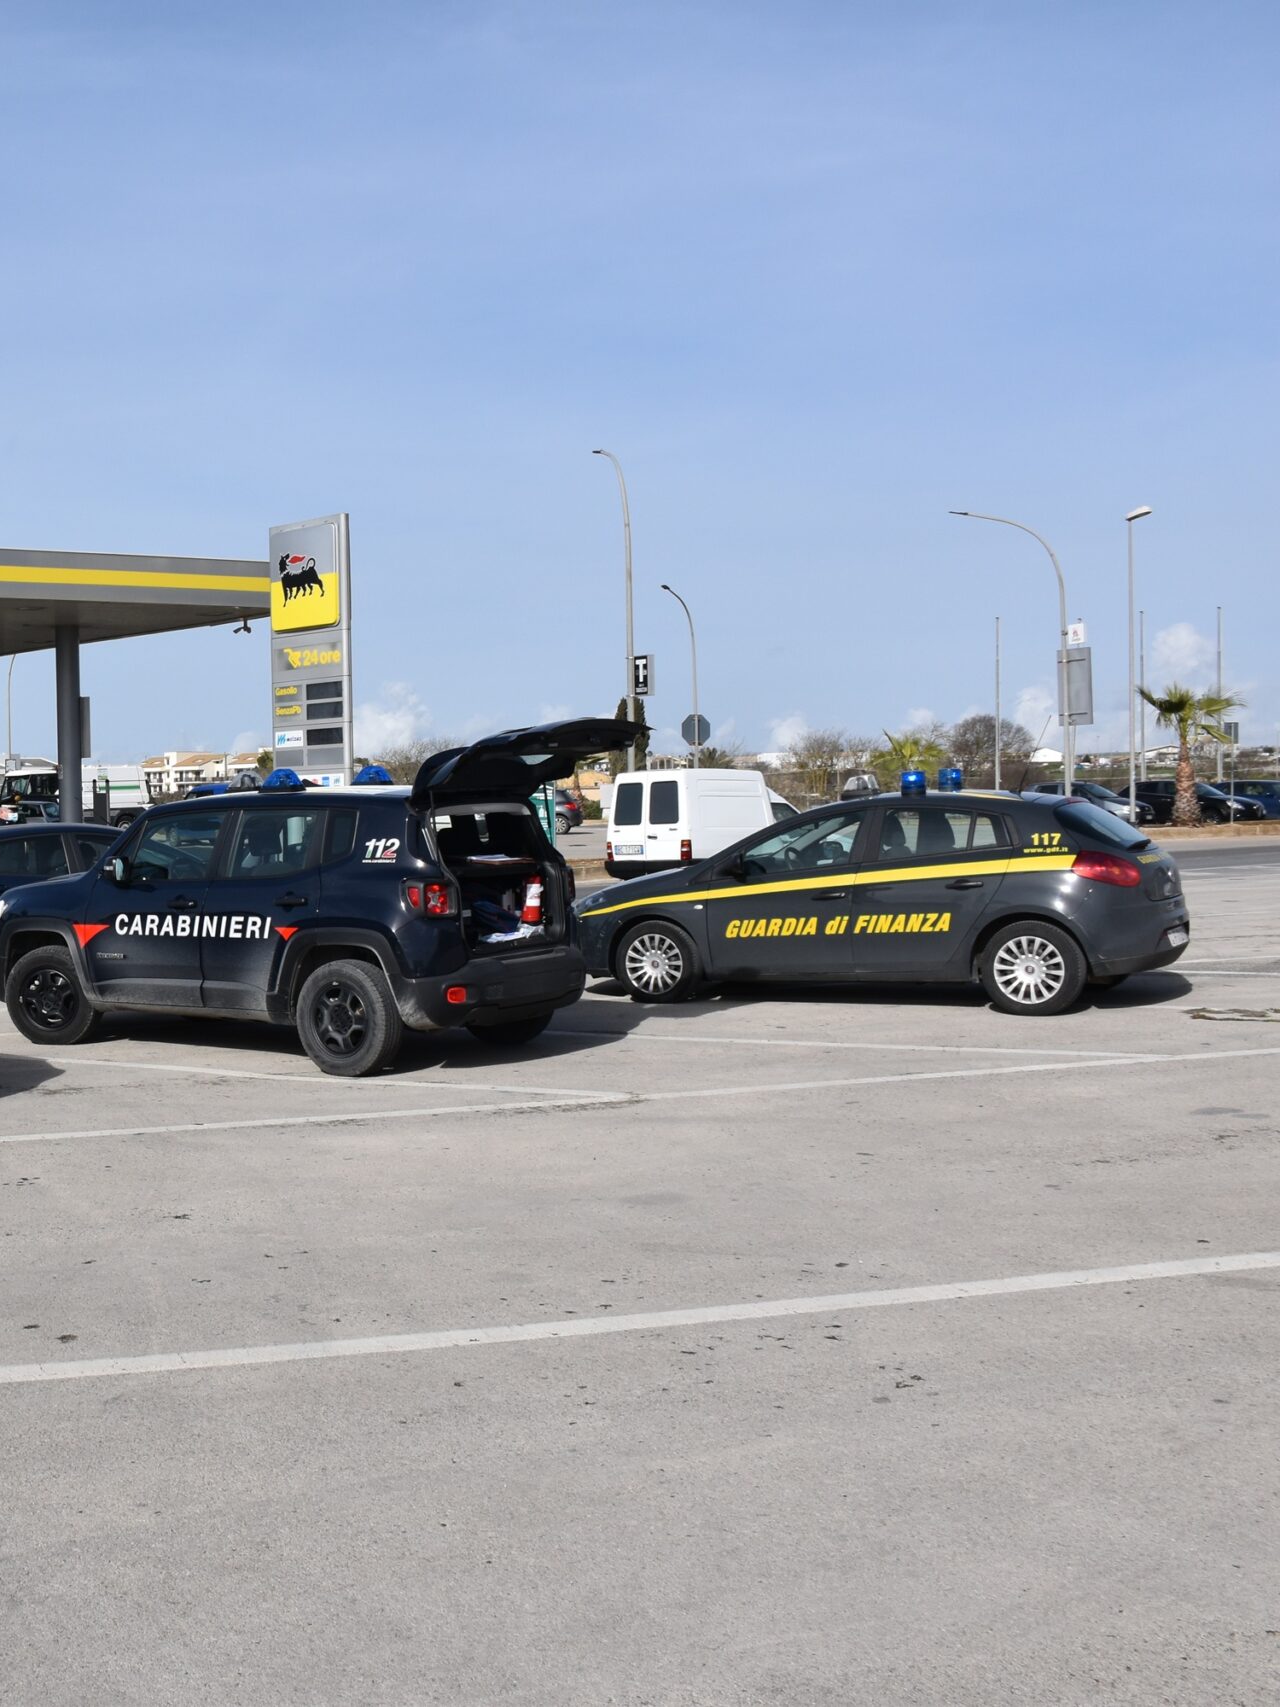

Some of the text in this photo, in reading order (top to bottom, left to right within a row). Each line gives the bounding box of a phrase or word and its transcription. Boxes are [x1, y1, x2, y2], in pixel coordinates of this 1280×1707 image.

[303, 649, 341, 667] 24 ore
[365, 838, 401, 859] 112
[1031, 833, 1061, 846] 117
[115, 913, 271, 939] CARABINIERI
[725, 912, 951, 938] GUARDIA di FINANZA
